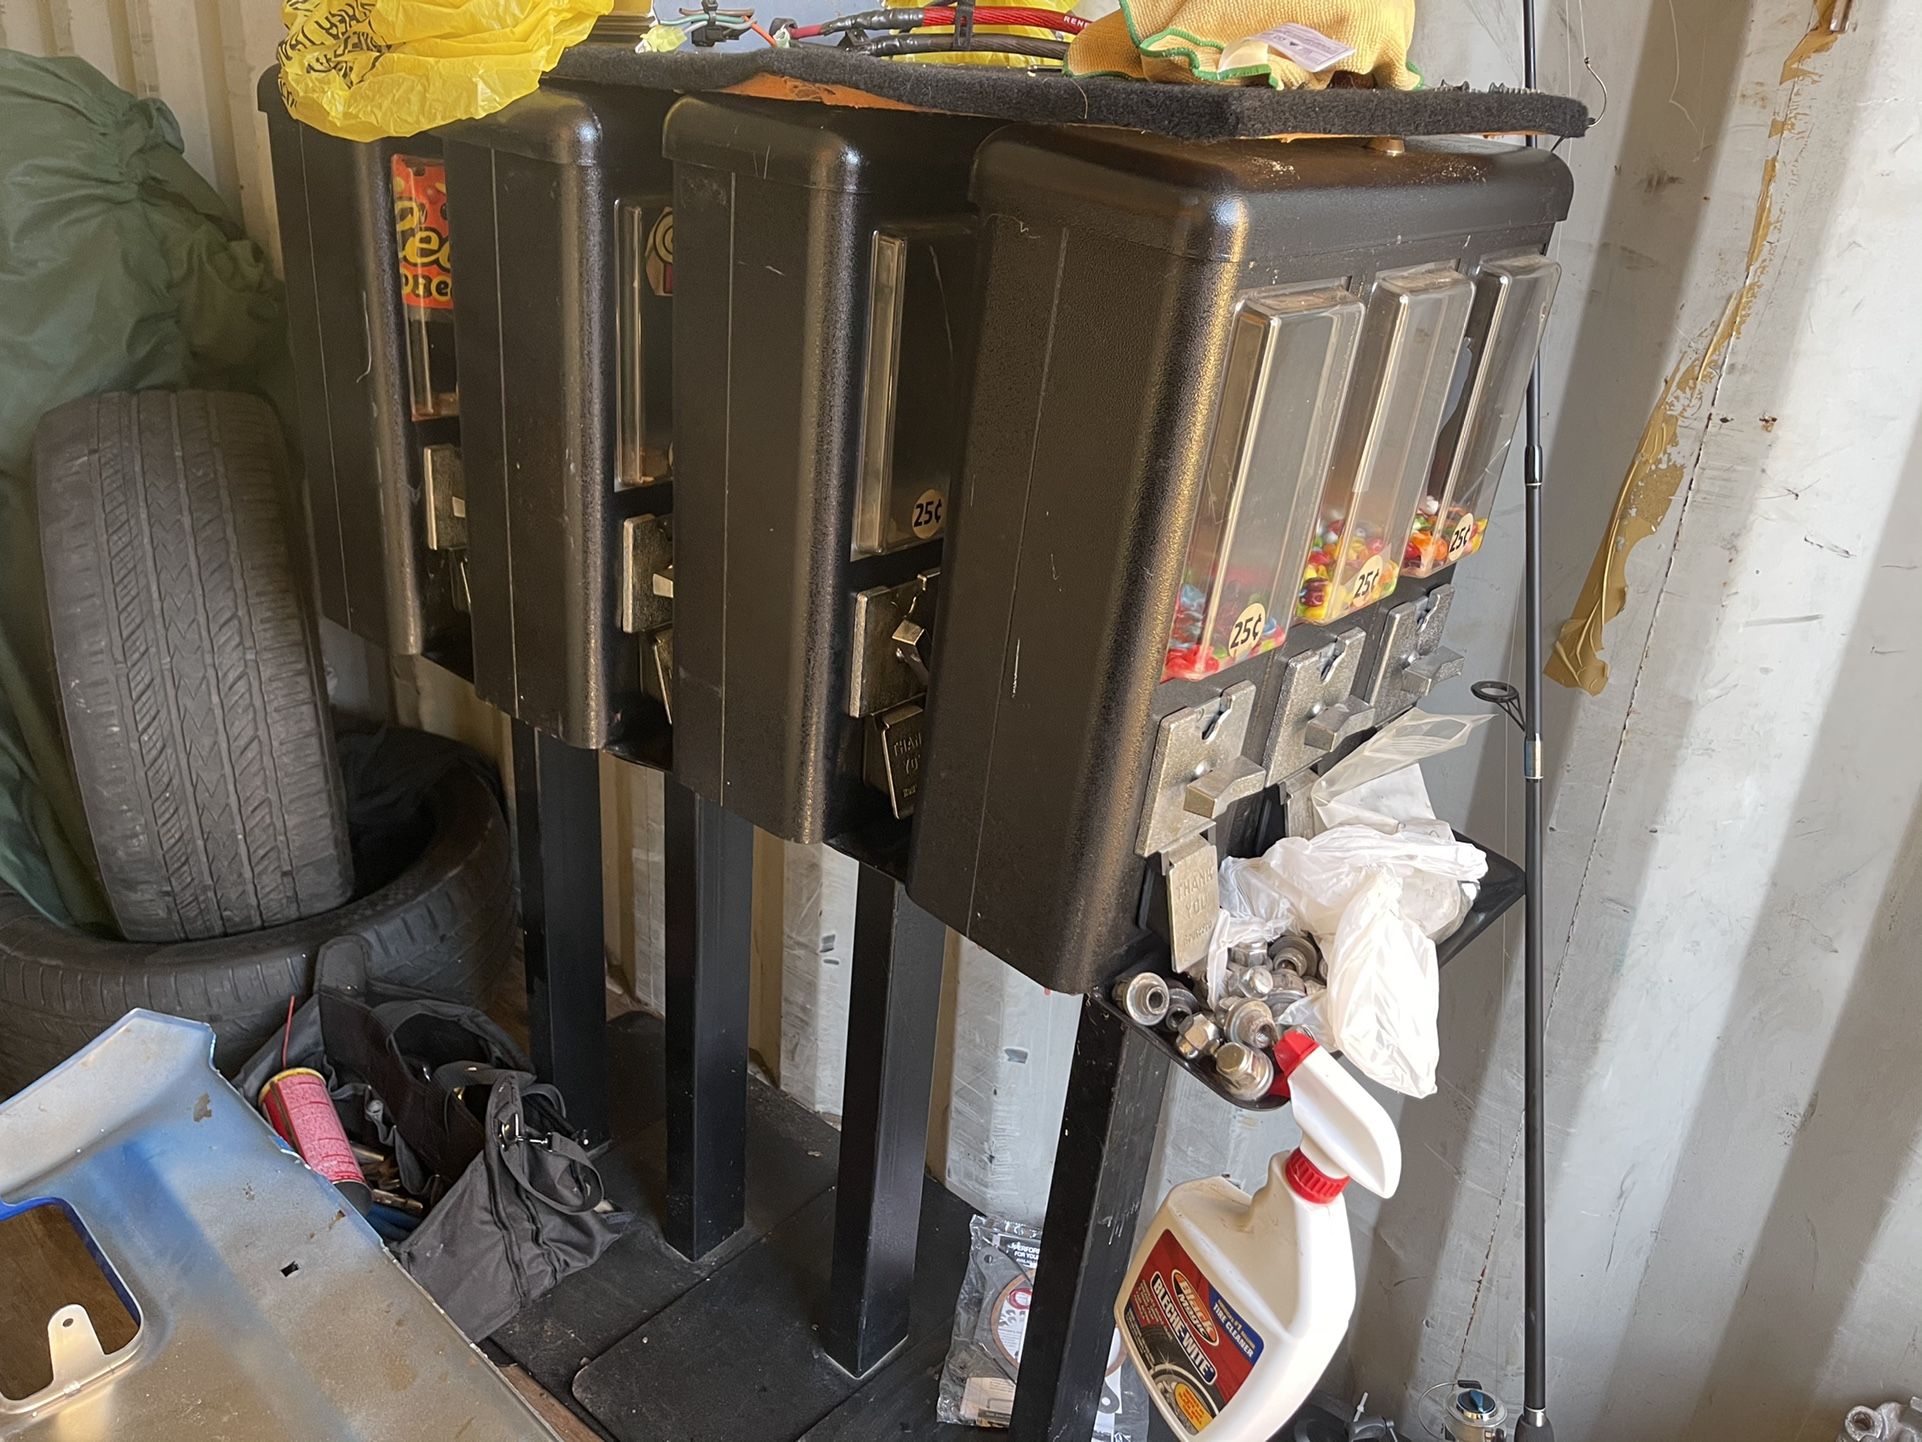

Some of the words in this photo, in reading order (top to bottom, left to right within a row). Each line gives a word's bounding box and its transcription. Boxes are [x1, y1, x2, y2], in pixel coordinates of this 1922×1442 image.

[914, 499, 942, 527] 25¢
[1449, 525, 1471, 554] 25¢
[1353, 568, 1380, 602] 25¢
[1230, 613, 1263, 650] 25¢
[1175, 867, 1215, 901] THANK
[1185, 896, 1209, 920] YOU
[1179, 1280, 1215, 1334] Black
[1153, 1278, 1211, 1376] BLECHE-WITE
[1213, 1303, 1227, 1322] TIRE
[1225, 1321, 1254, 1357] CLEANER
